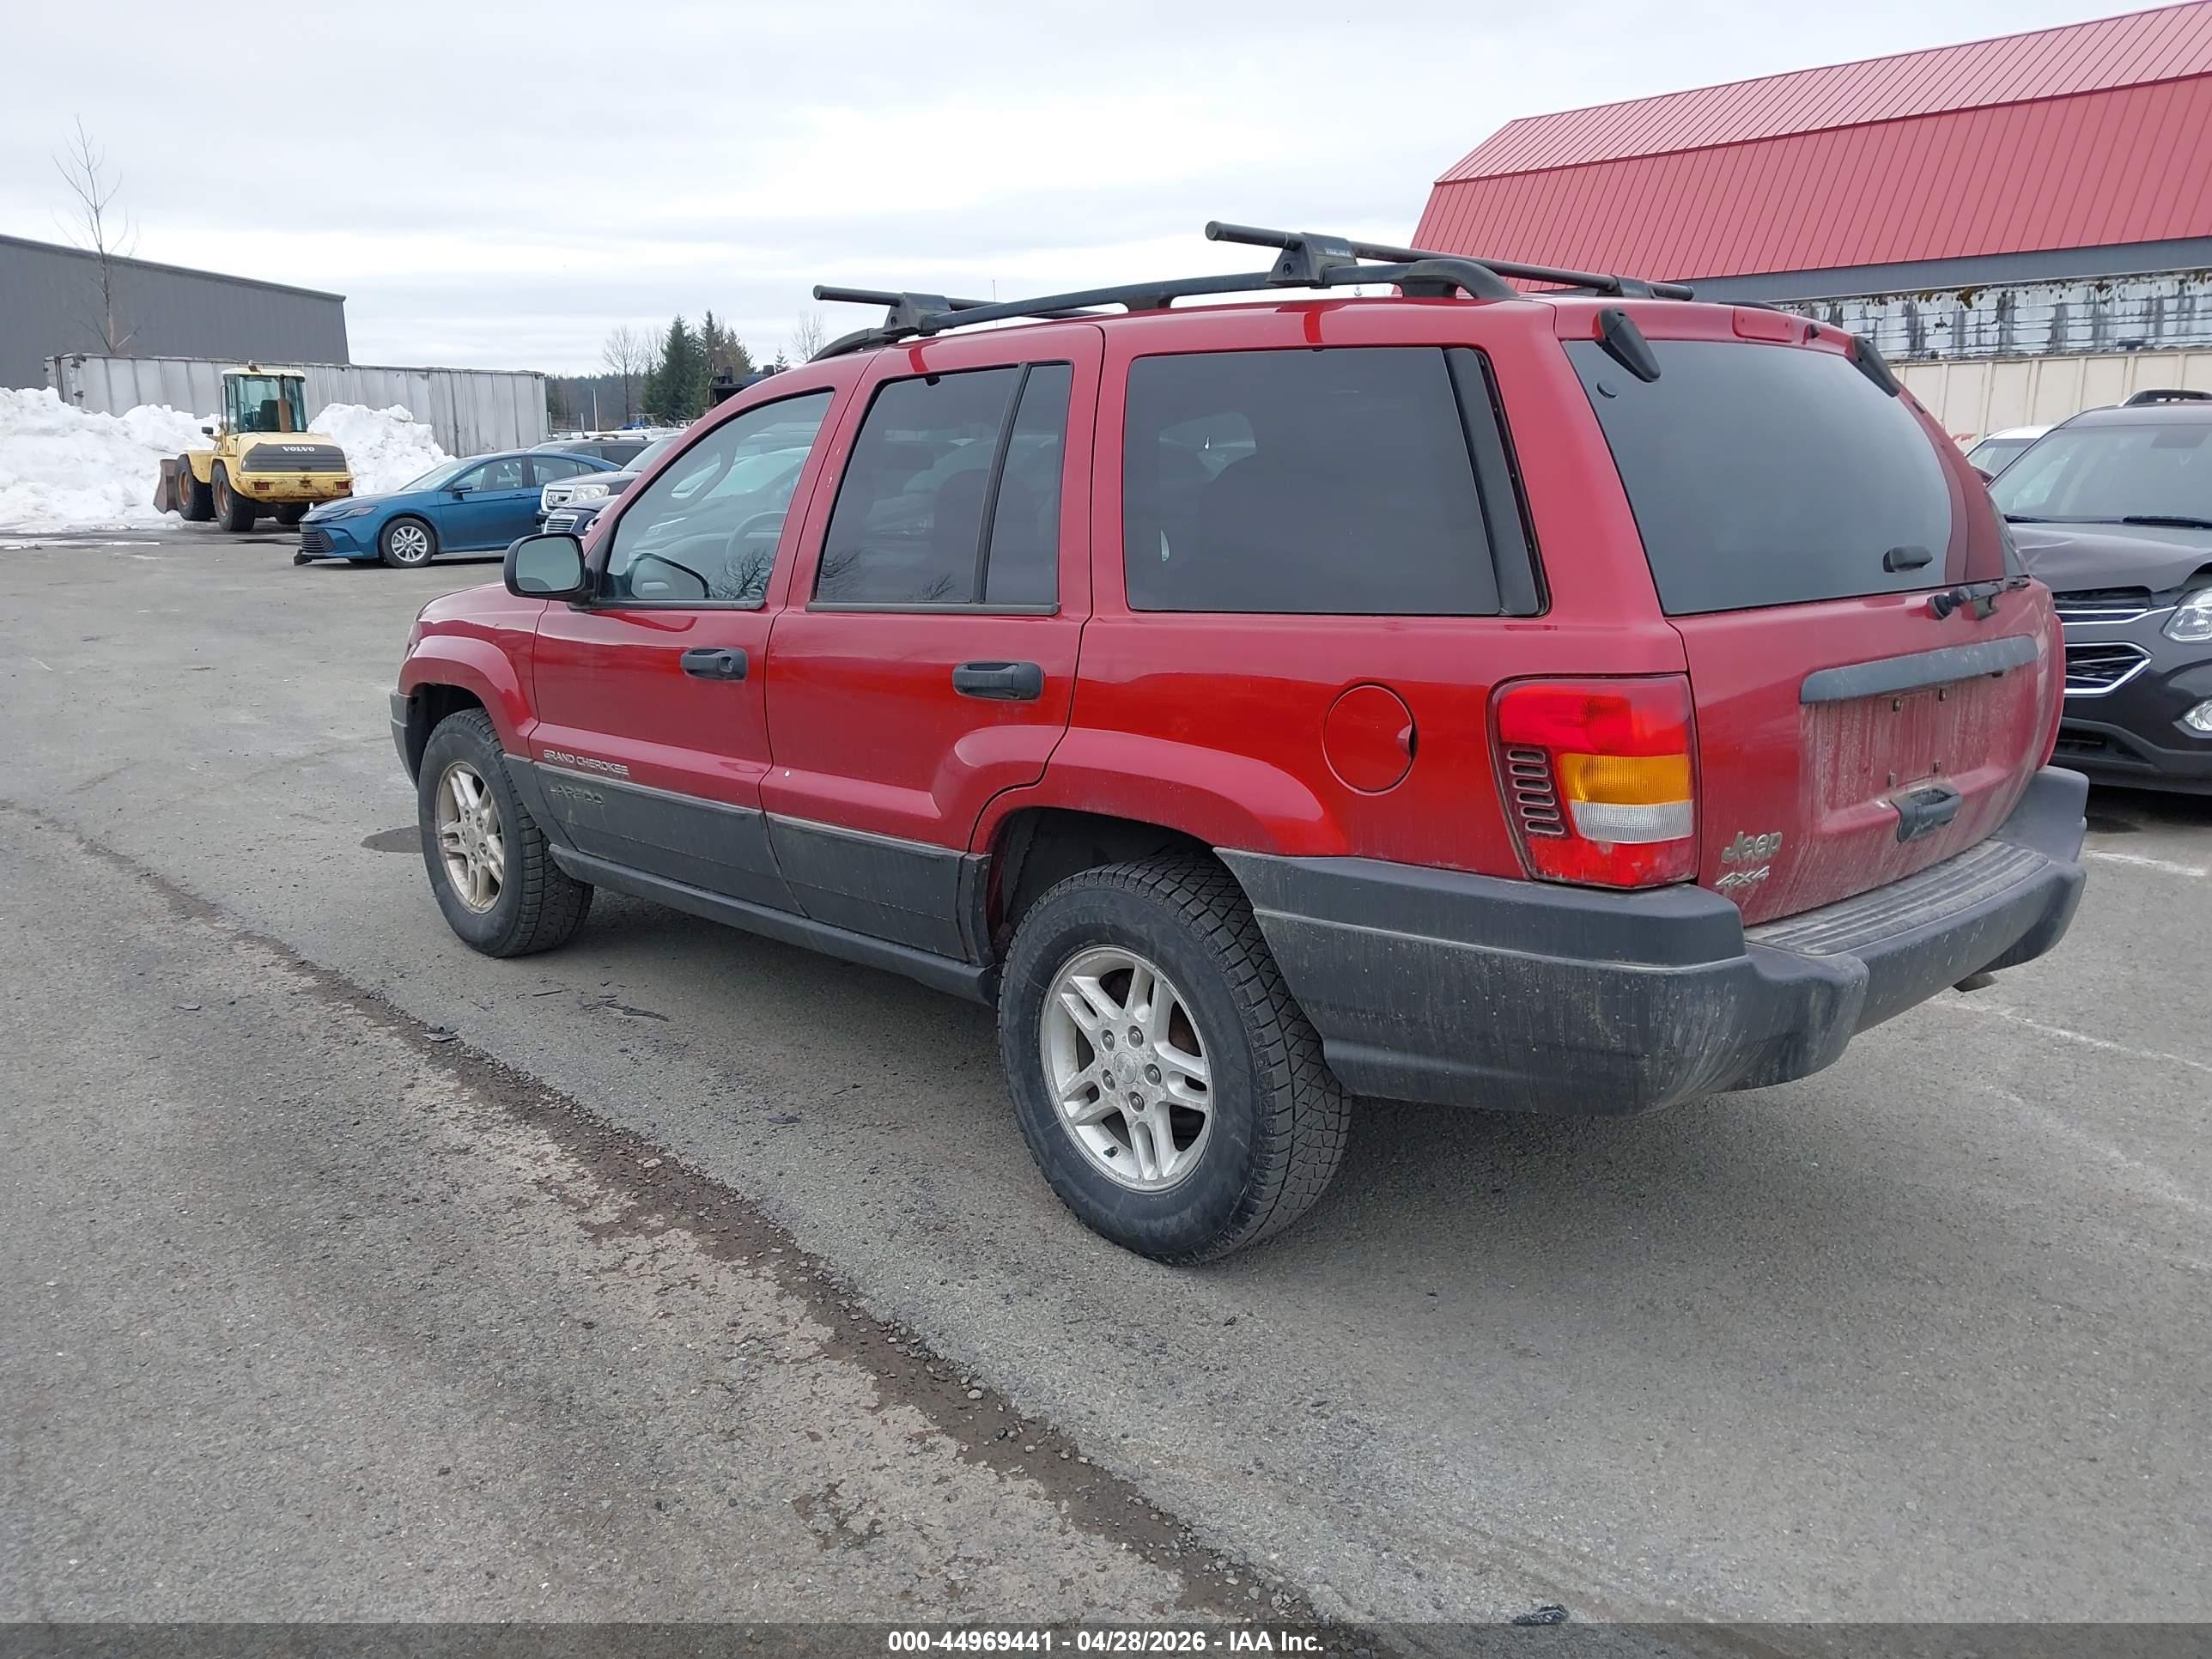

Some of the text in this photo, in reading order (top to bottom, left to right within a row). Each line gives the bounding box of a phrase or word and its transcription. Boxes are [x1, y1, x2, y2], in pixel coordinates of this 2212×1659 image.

[543, 749, 629, 775] GRAND CHEROKEE
[550, 783, 605, 805] LAREDO
[1721, 831, 1783, 864] Jeep
